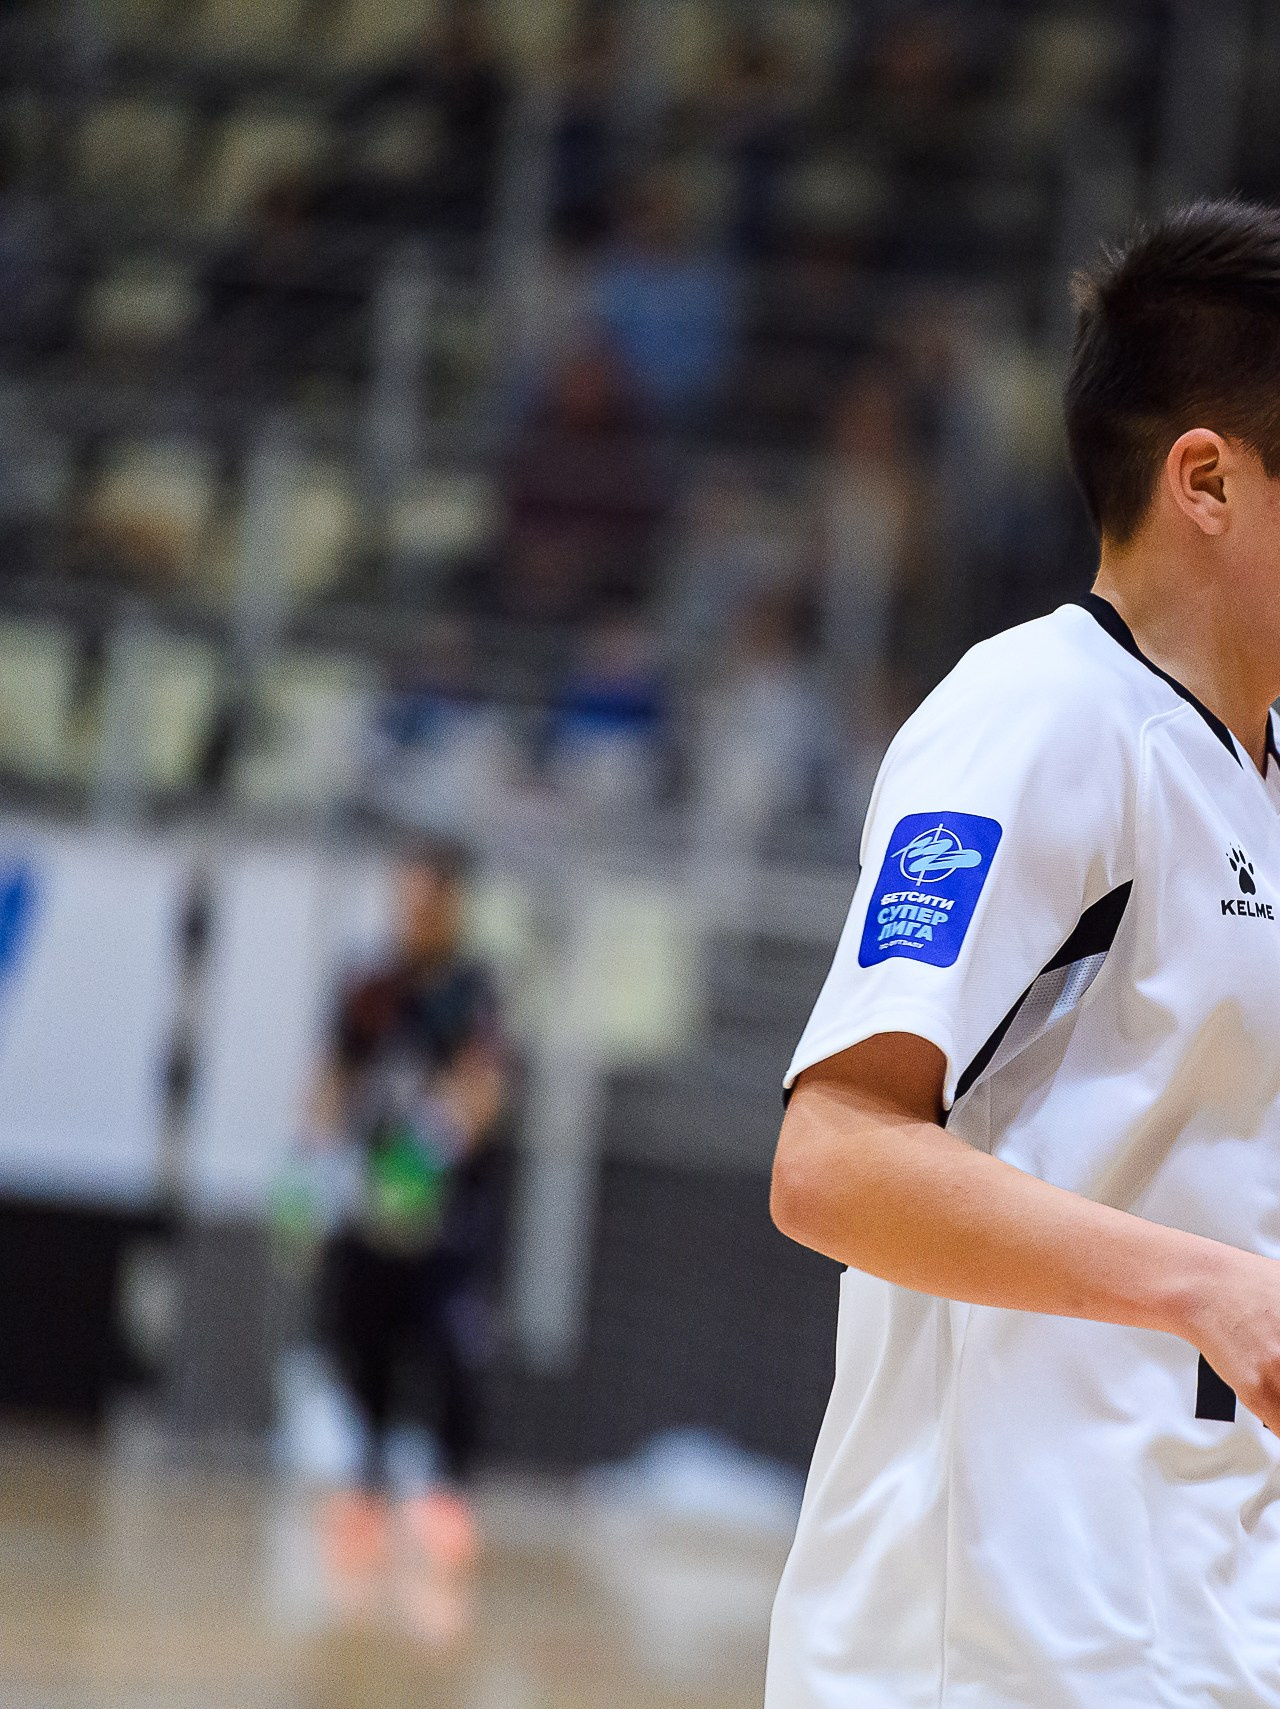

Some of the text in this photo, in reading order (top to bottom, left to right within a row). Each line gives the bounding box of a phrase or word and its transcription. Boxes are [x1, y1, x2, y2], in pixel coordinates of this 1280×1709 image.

[880, 891, 955, 910] БЕТСИТИ
[1220, 899, 1275, 921] KELME
[876, 904, 949, 926] СУПЕР
[876, 920, 933, 942] ЛИГА
